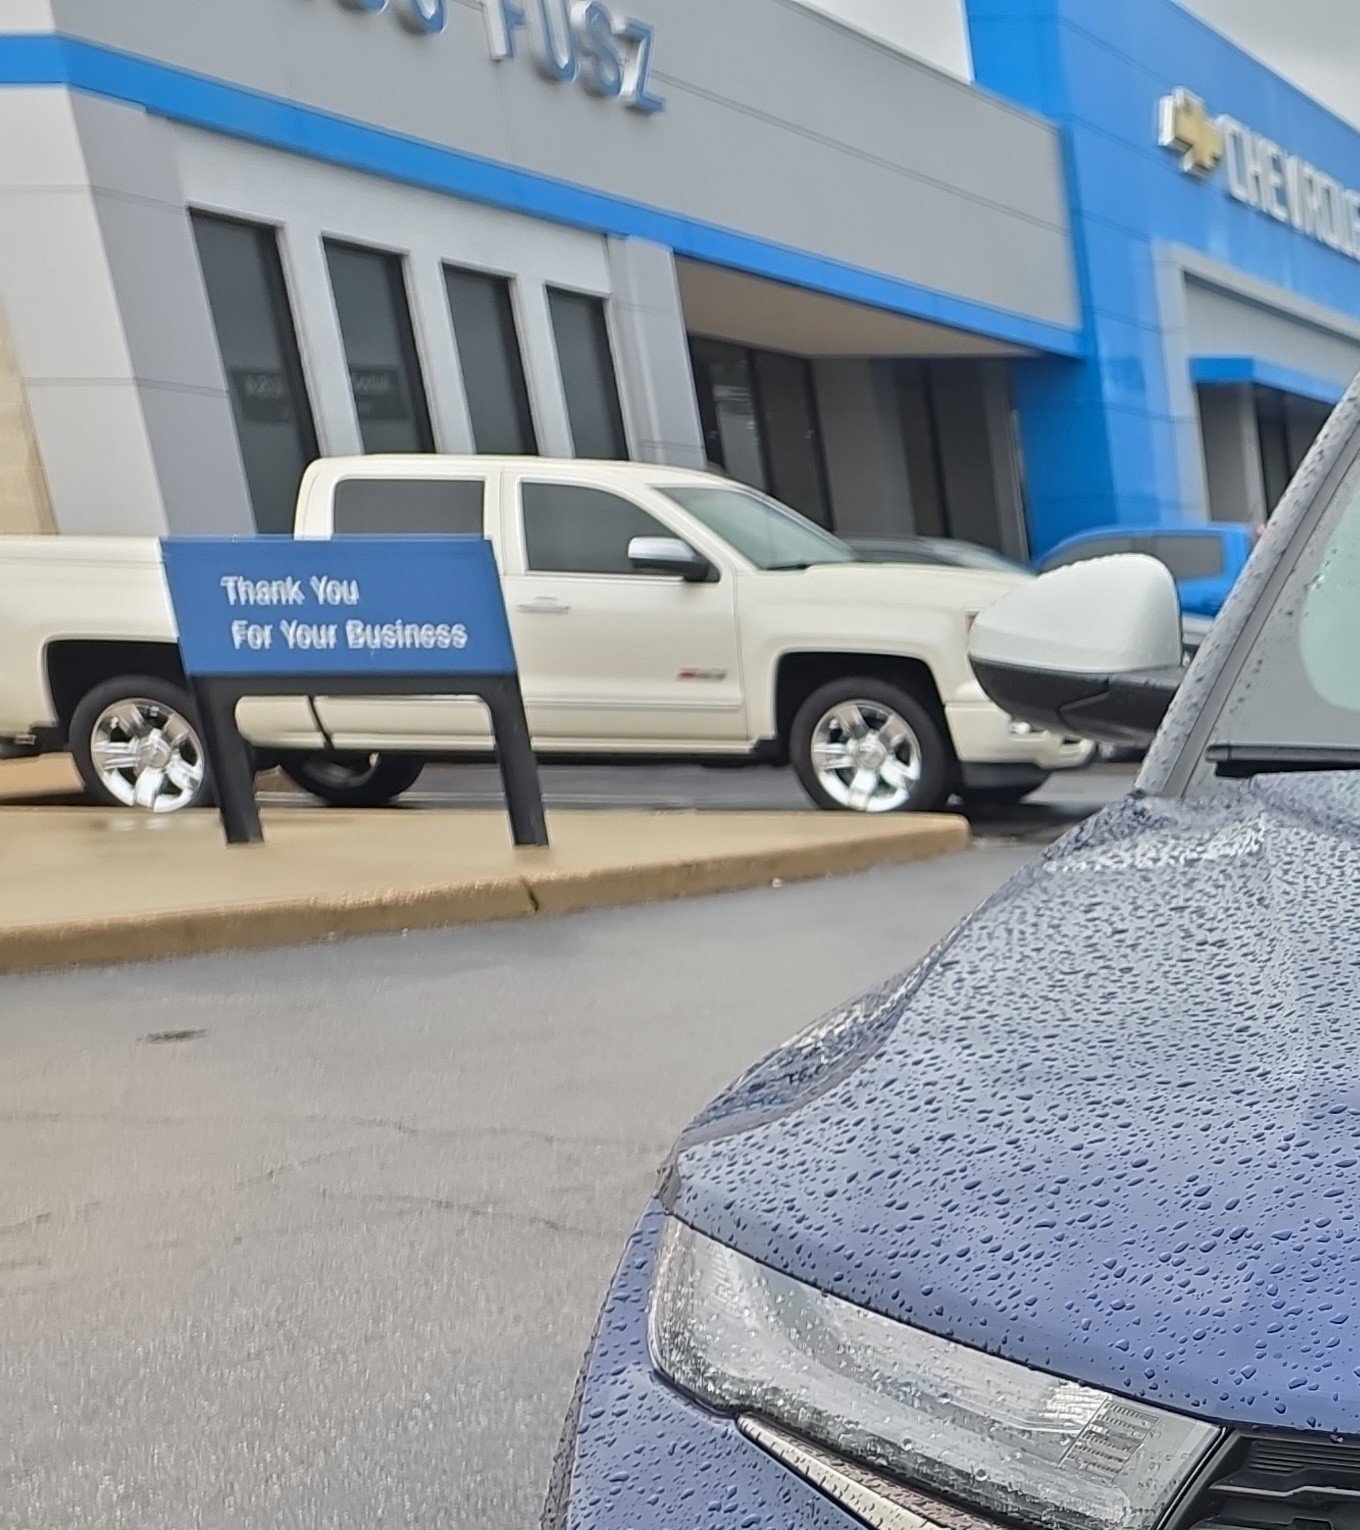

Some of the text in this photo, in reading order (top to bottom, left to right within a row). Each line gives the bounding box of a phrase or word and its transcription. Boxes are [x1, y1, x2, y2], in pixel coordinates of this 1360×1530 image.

[220, 575, 360, 606] Thank You
[231, 618, 468, 650] For Your Business
